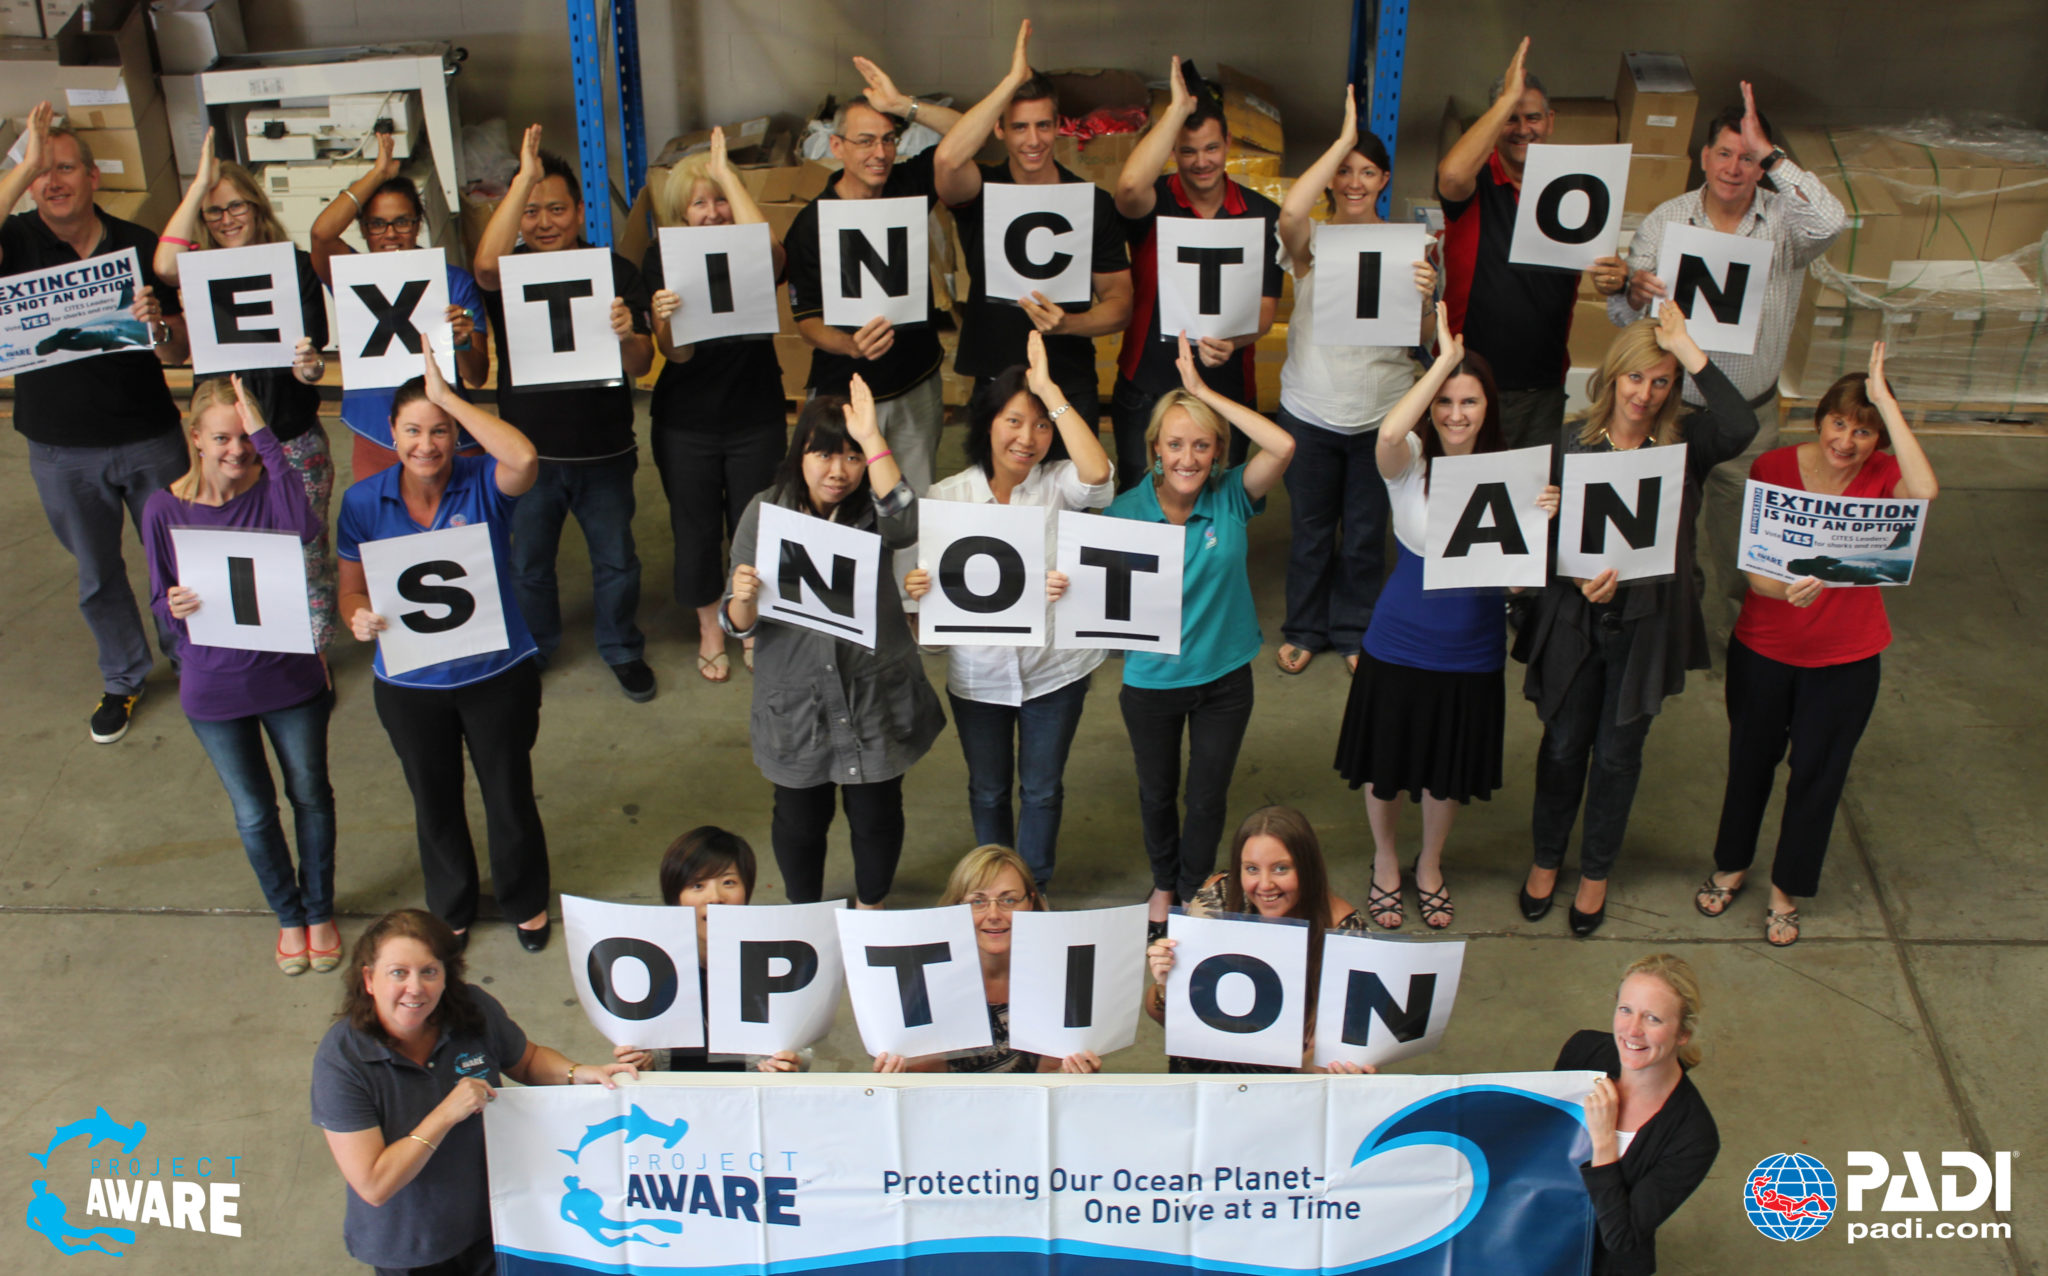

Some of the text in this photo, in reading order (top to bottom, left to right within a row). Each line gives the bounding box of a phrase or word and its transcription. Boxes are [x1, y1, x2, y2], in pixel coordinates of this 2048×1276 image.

[1535, 173, 1611, 245] O
[0, 257, 132, 300] EXTINCTION
[838, 226, 909, 299] N
[1003, 211, 1074, 280] C
[1177, 246, 1244, 316] T
[16, 296, 48, 312] NOT
[52, 291, 74, 304] AN
[78, 277, 136, 300] OPTION
[21, 316, 48, 329] YES
[87, 307, 101, 315] and
[64, 303, 85, 312] CITES
[207, 273, 281, 345] E
[350, 279, 431, 358] X
[522, 278, 593, 353] T
[1673, 253, 1751, 326] N
[1442, 481, 1529, 558] A
[1579, 476, 1662, 555] N
[1764, 509, 1917, 533] IS NOT AN OPTION
[1764, 530, 1783, 539] Vote
[1784, 531, 1812, 546] YES
[1814, 540, 1826, 548] for
[1766, 490, 1920, 518] EXTINCTION
[1831, 534, 1854, 542] CITES
[396, 559, 476, 634] S
[777, 538, 857, 619] N
[938, 535, 1026, 614] O
[1079, 545, 1159, 622] T
[587, 937, 678, 1021] O
[740, 940, 819, 1024] P
[865, 941, 952, 1028] T
[1189, 953, 1284, 1034] O
[1341, 969, 1438, 1047] N
[628, 1151, 799, 1173] PROJECT
[884, 1166, 1326, 1202] Protecting Our Ocean Planet-
[626, 1173, 802, 1227] AWARE
[1085, 1195, 1361, 1224] One Dive at a Time
